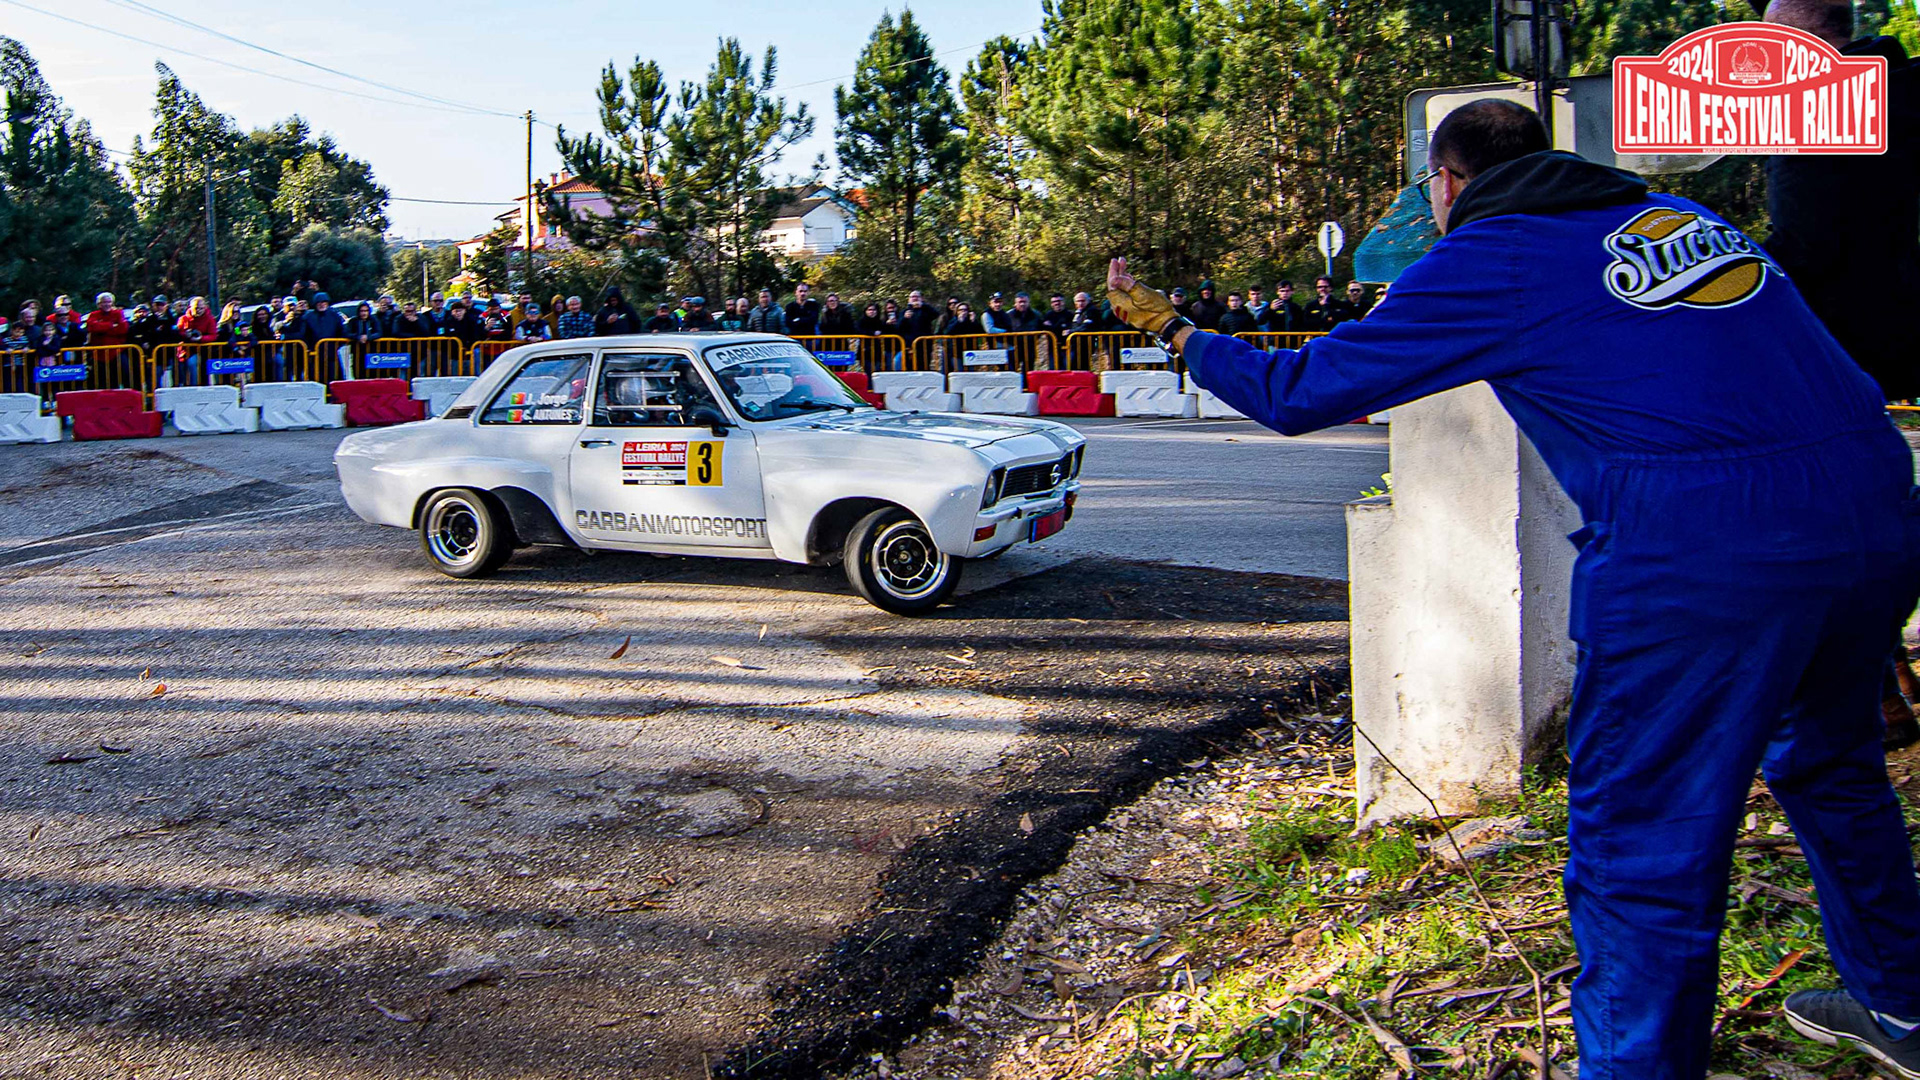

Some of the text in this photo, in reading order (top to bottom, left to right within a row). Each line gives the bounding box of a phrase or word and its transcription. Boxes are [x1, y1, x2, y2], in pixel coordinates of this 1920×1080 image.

[635, 443, 668, 452] LEIRIA
[623, 452, 685, 463] FESTIVAL RALLYE
[697, 442, 712, 484] 3
